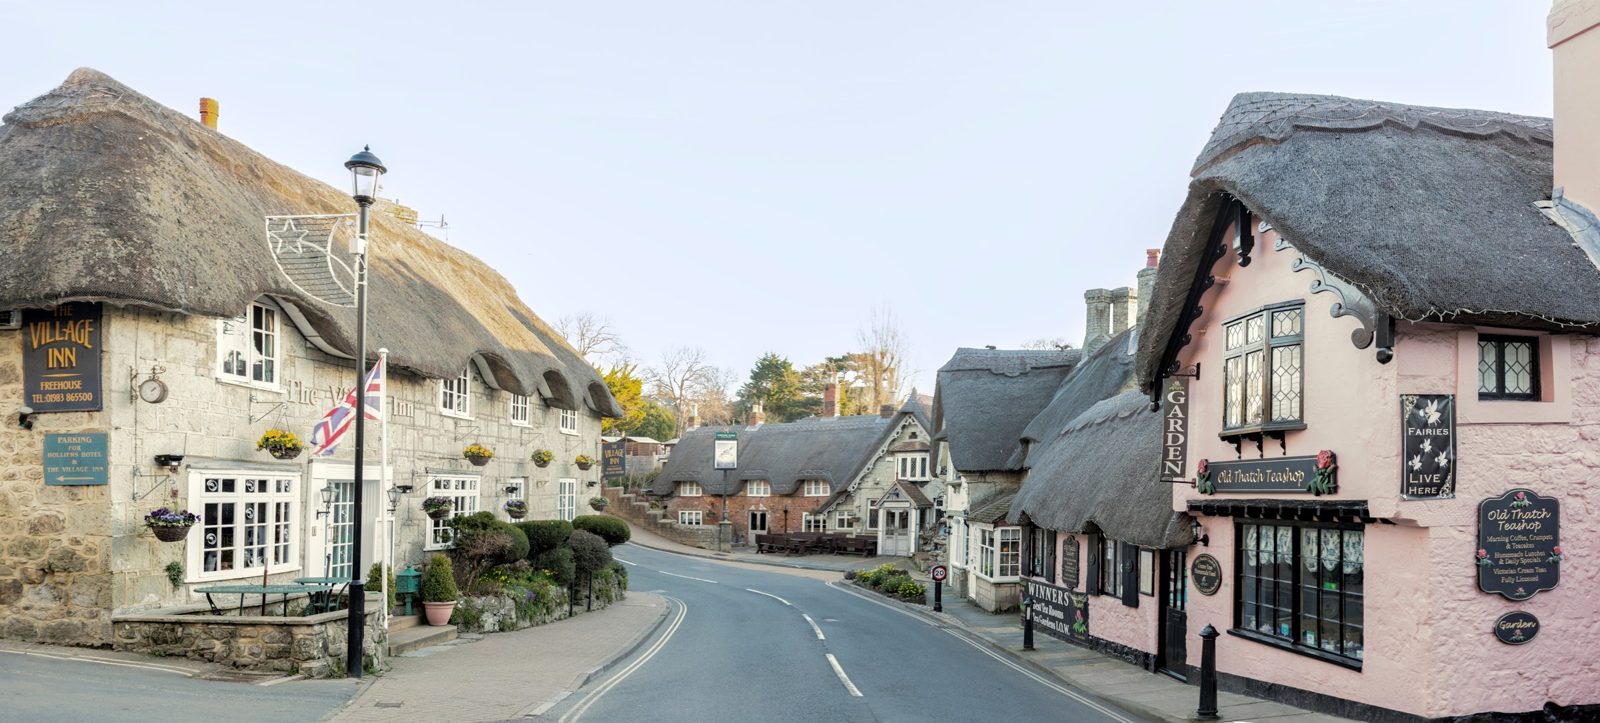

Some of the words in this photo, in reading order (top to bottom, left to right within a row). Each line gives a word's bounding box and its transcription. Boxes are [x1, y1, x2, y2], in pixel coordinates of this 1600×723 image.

[54, 305, 72, 316] THE
[30, 319, 94, 350] VILLAGE
[48, 347, 76, 369] INN
[40, 380, 82, 391] FREEHOUSE
[32, 393, 64, 403] TEL:01983
[66, 392, 92, 402] 865500
[286, 379, 318, 405] The
[391, 396, 414, 417] Inn
[1164, 390, 1186, 474] GARDEN
[1217, 470, 1232, 484] Old
[1234, 468, 1264, 483] Thatch
[1266, 468, 1305, 487] Teashop
[1488, 509, 1510, 520] Old
[1511, 508, 1551, 519] Thatch
[1497, 520, 1542, 532] Teashop
[1028, 582, 1069, 606] WINNERS
[1048, 605, 1064, 619] Rooms
[1039, 615, 1056, 630] Gardens
[1499, 619, 1536, 630] Garden
